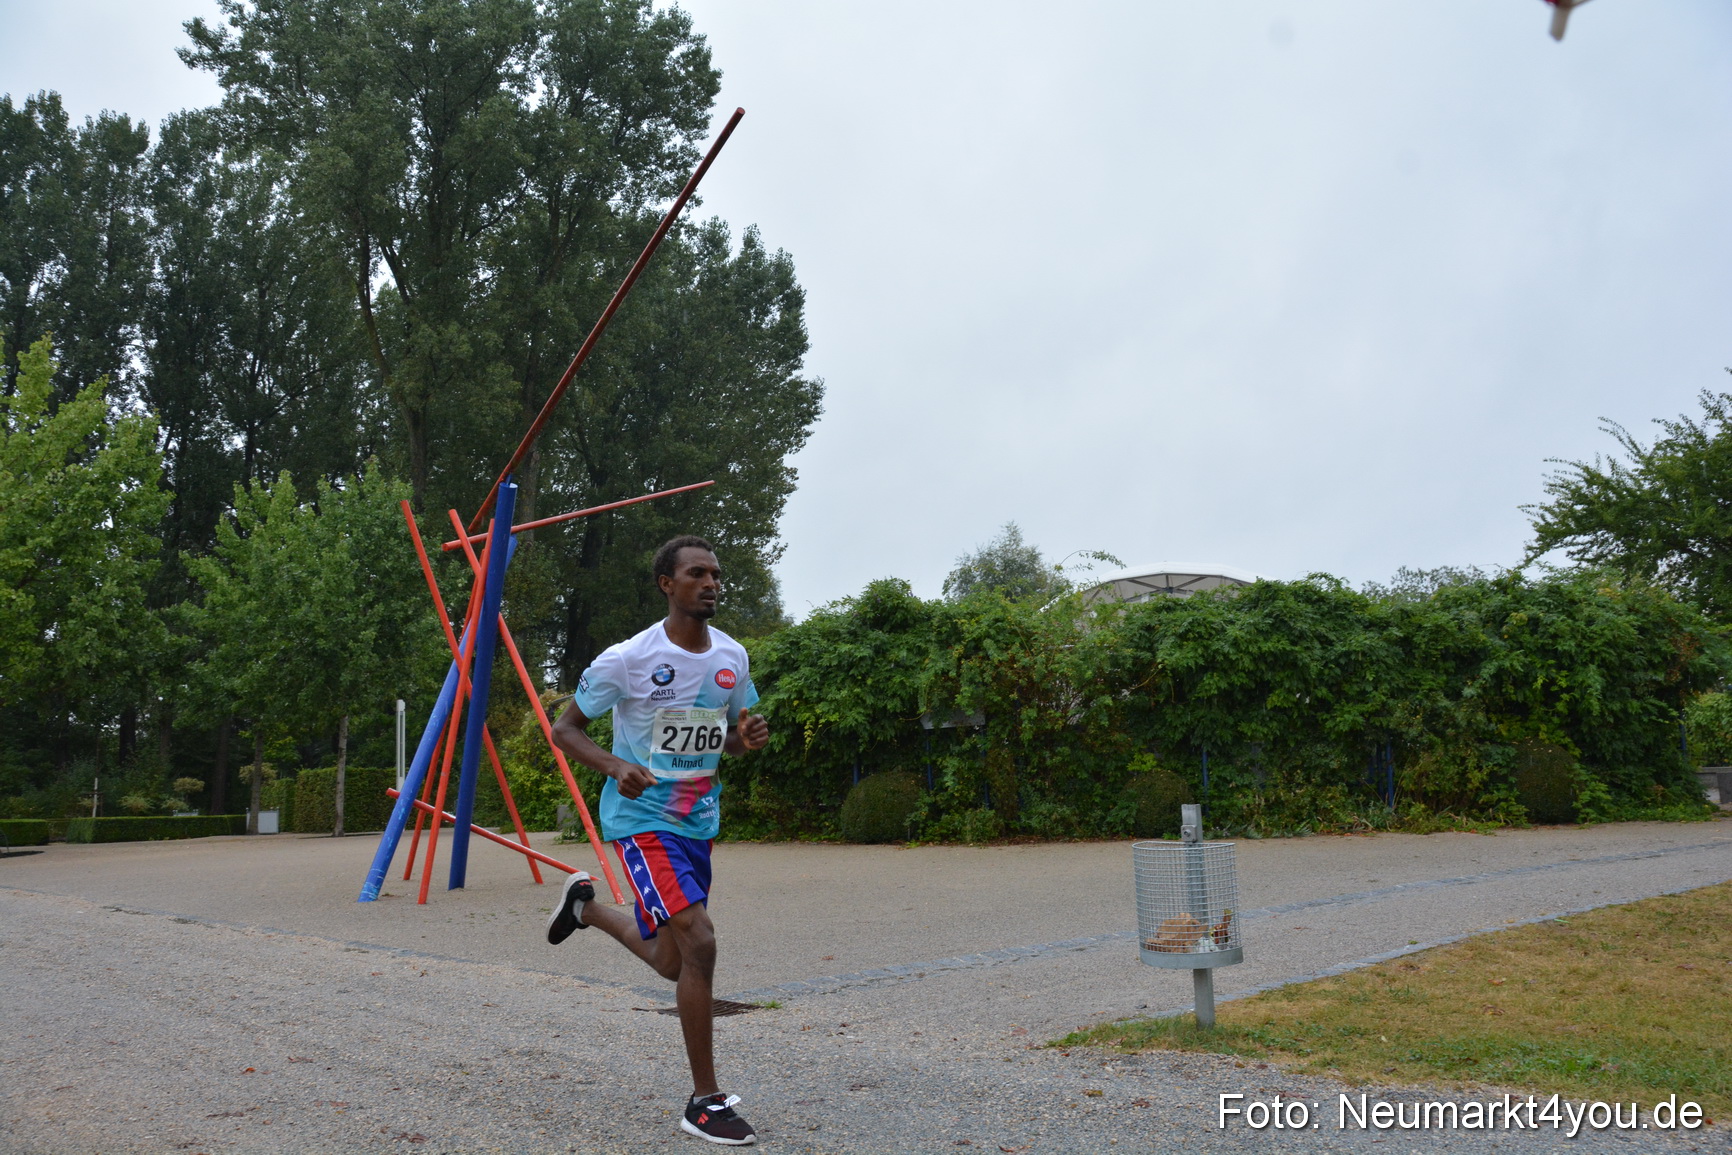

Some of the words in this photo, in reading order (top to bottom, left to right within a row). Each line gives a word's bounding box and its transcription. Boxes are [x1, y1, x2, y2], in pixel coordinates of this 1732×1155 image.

[651, 688, 676, 697] PARTL
[660, 725, 723, 752] 2766
[671, 757, 704, 769] Ahmad
